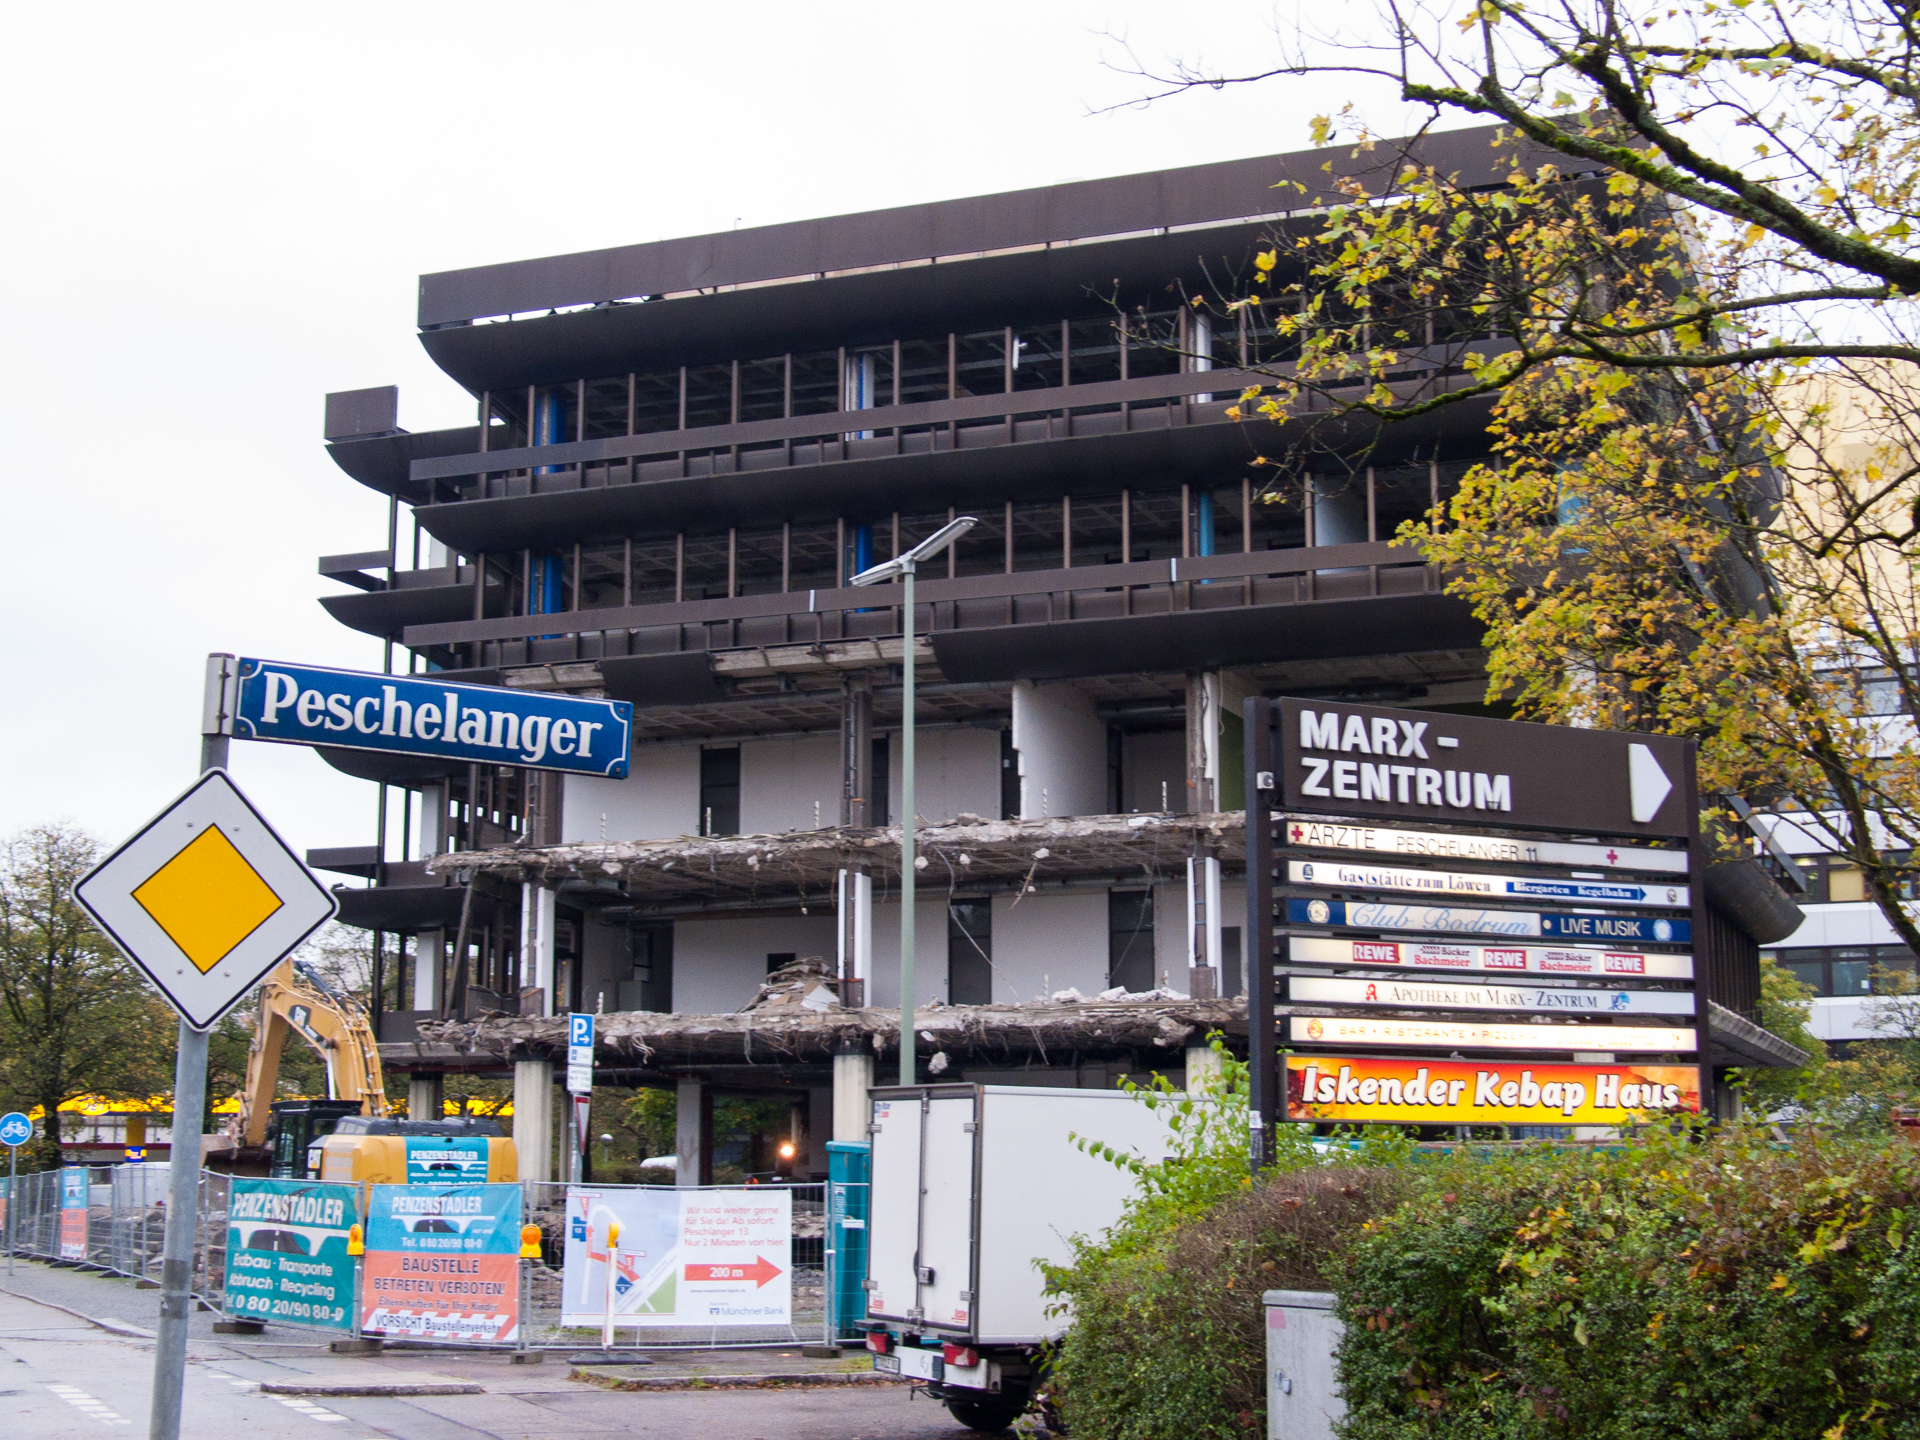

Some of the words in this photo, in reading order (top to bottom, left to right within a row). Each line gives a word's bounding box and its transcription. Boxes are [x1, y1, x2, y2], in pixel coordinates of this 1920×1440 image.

[260, 671, 603, 763] Peschelanger
[1301, 757, 1512, 812] ZENTRUM
[1307, 822, 1376, 849] ÄRZTE
[1396, 835, 1519, 861] PESCHELANGER
[1525, 846, 1538, 862] 11
[1338, 866, 1413, 888] Gaststätte
[1416, 876, 1443, 889] zum
[1448, 874, 1491, 893] Löwen
[1513, 881, 1571, 895] Biergarten
[1577, 885, 1632, 899] Kegelbahn
[1352, 903, 1414, 928] Club
[1422, 907, 1530, 936] Bodrum
[1560, 917, 1591, 935] LIVE
[1594, 918, 1642, 937] MUSIK
[1353, 944, 1395, 961] REWE
[1441, 946, 1471, 957] Bäcker
[1484, 951, 1524, 967] REWE
[1565, 952, 1593, 962] Bäcker
[1414, 954, 1471, 967] Bachmeier
[1539, 960, 1593, 973] Bachmeier
[1605, 955, 1642, 972] REWE
[572, 1017, 588, 1044] P
[1340, 1026, 1366, 1036] BAR
[1383, 1027, 1465, 1039] RISTORANTE
[1482, 1030, 1538, 1041] PIZZERIA
[1301, 1065, 1466, 1106] Iskender
[1473, 1070, 1586, 1117] Kebap
[1594, 1074, 1680, 1109] Haus
[410, 1150, 478, 1160] PENZENSTADLER
[231, 1192, 344, 1226] PENZENSTADLER
[391, 1195, 482, 1214] PENZENSTADLER
[686, 1206, 701, 1215] Wir
[703, 1206, 721, 1214] sind
[724, 1206, 751, 1215] weiter
[754, 1207, 779, 1217] gerne
[685, 1216, 698, 1225] für
[701, 1216, 714, 1225] Sie
[732, 1216, 745, 1225] Ab
[684, 1227, 736, 1238] Peschlanger
[402, 1236, 417, 1248] Tel.
[684, 1238, 701, 1247] Nur
[702, 1239, 709, 1247] 2
[710, 1238, 747, 1247] Minuten
[232, 1252, 271, 1270] Erdbau
[278, 1257, 334, 1277] Transporte
[402, 1256, 480, 1274] BAUSTELLE
[709, 1266, 731, 1278] 200
[732, 1268, 744, 1278] m
[228, 1272, 274, 1291] Abbruch
[279, 1278, 336, 1302] Recycling
[373, 1277, 434, 1294] BETRETEN
[437, 1281, 506, 1296] VERBOTEN!
[378, 1296, 404, 1308] Eltern
[406, 1298, 434, 1309] haften
[436, 1299, 450, 1310] für
[452, 1300, 469, 1312] Ihre
[470, 1302, 499, 1313] Kinder
[721, 1306, 763, 1316] Münchner
[764, 1306, 785, 1315] Bank
[375, 1312, 422, 1330] VORSICHT
[425, 1317, 502, 1335] Baustellenverkehr
